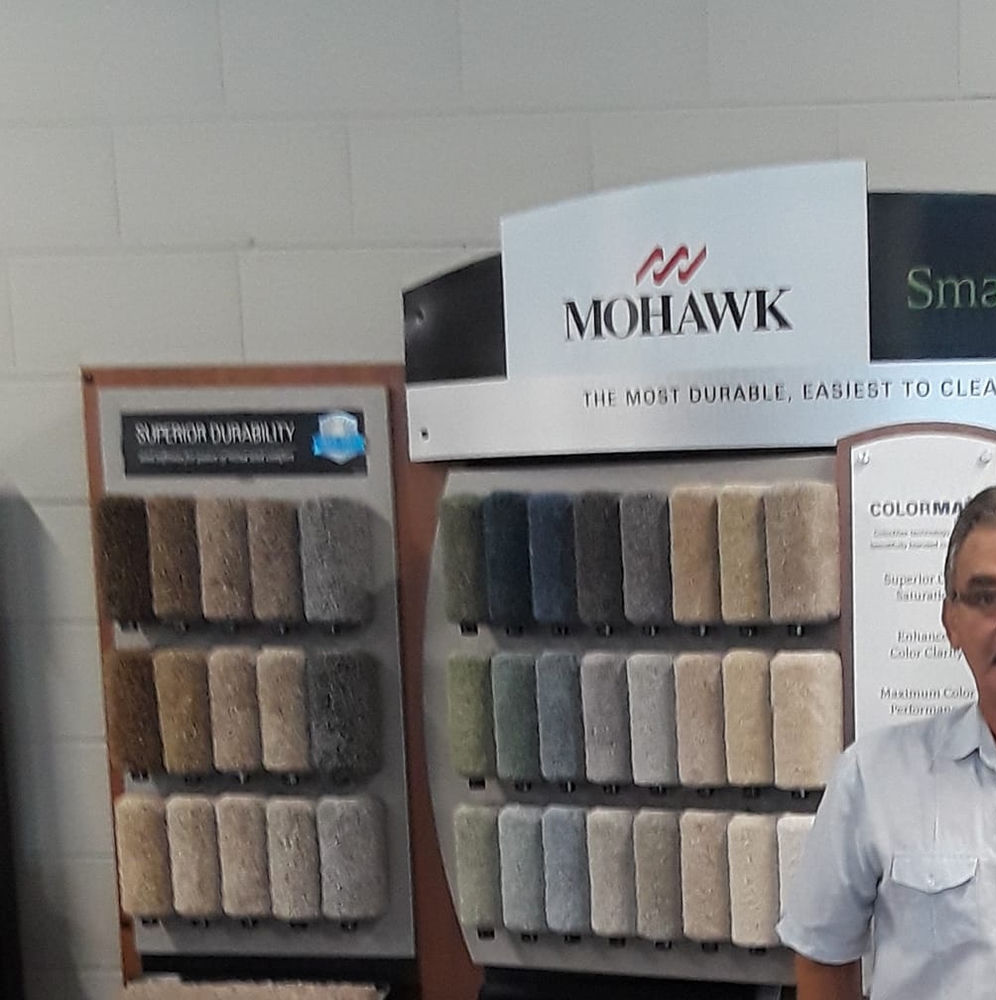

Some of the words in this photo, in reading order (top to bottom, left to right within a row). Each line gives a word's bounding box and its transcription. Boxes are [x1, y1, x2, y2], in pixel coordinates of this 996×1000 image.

[564, 288, 793, 341] MOHAWK
[584, 390, 617, 407] THE
[625, 388, 679, 407] MOST
[689, 384, 792, 403] DURABLE,
[803, 382, 892, 401] EASIEST
[902, 381, 931, 398] TO
[135, 421, 207, 444] SUPERIOR
[209, 420, 296, 443] DURABILITY
[870, 502, 966, 517] COLORMA
[890, 646, 921, 659] Color
[924, 645, 963, 661] Clarity
[880, 687, 941, 699] Maximum
[943, 686, 974, 699] Color
